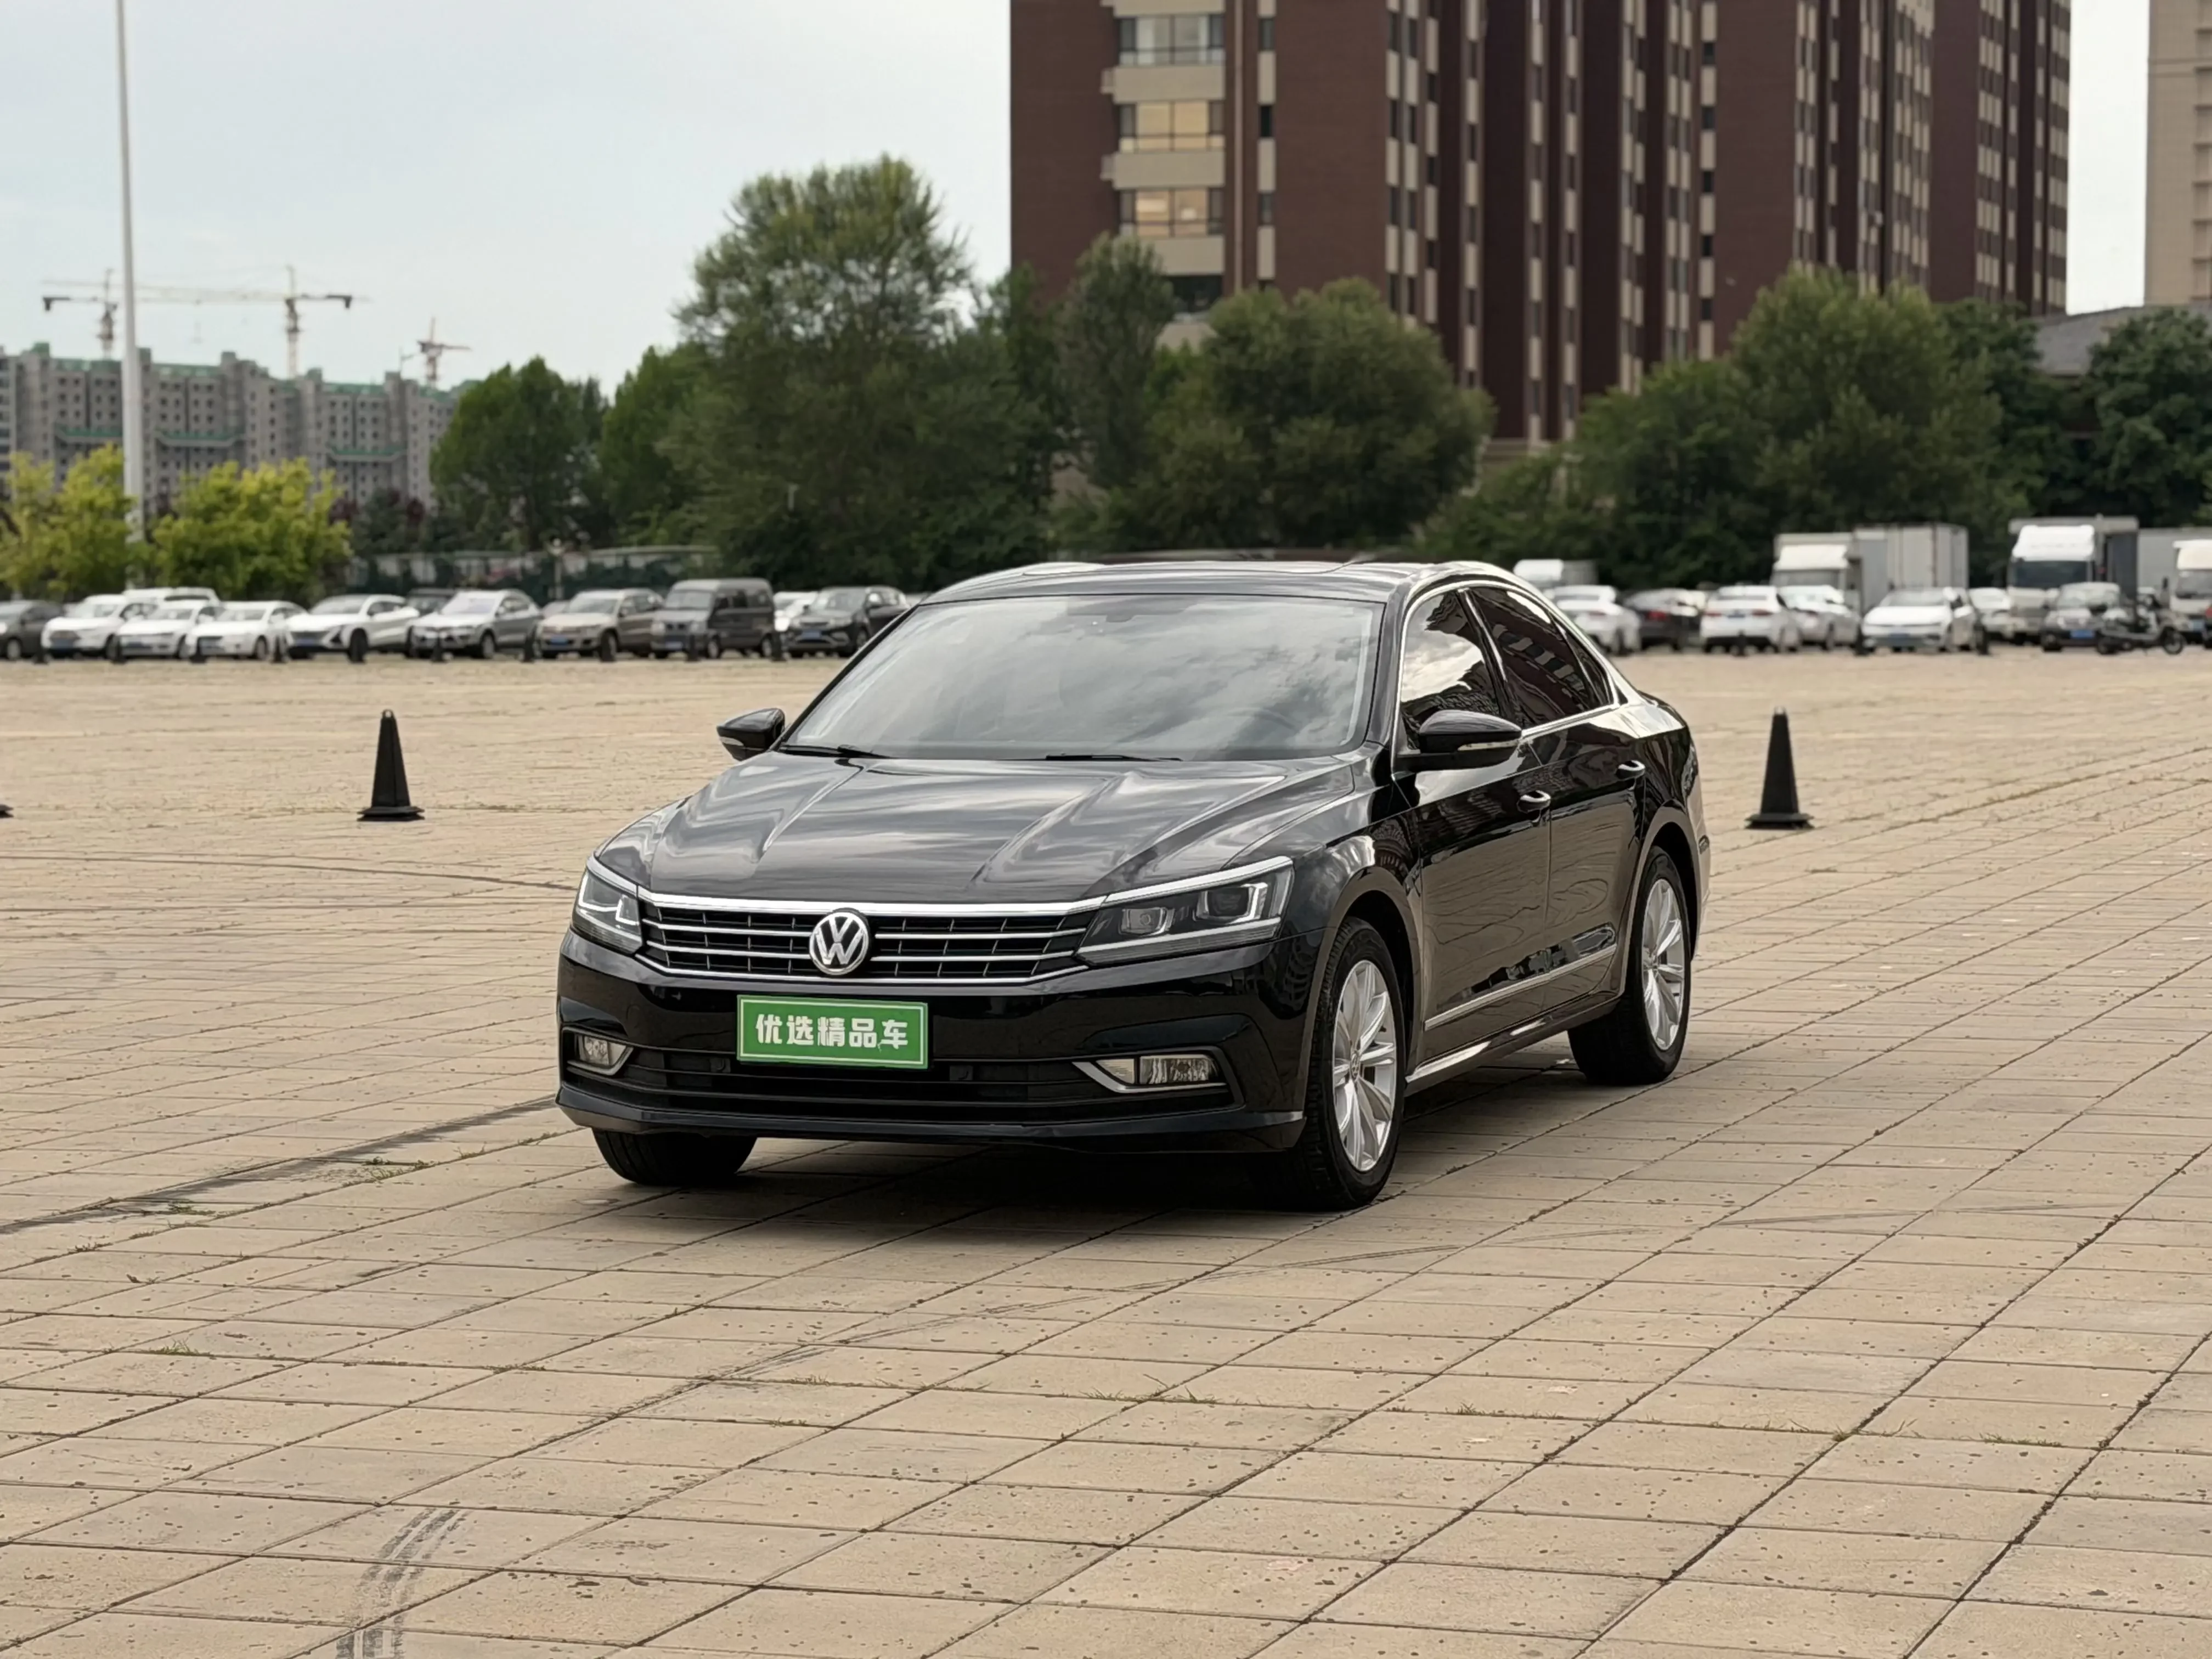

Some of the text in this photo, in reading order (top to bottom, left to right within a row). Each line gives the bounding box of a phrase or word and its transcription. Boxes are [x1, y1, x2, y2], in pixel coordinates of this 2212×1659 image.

[811, 913, 867, 970] VW
[755, 1014, 909, 1050] 优选精品车
